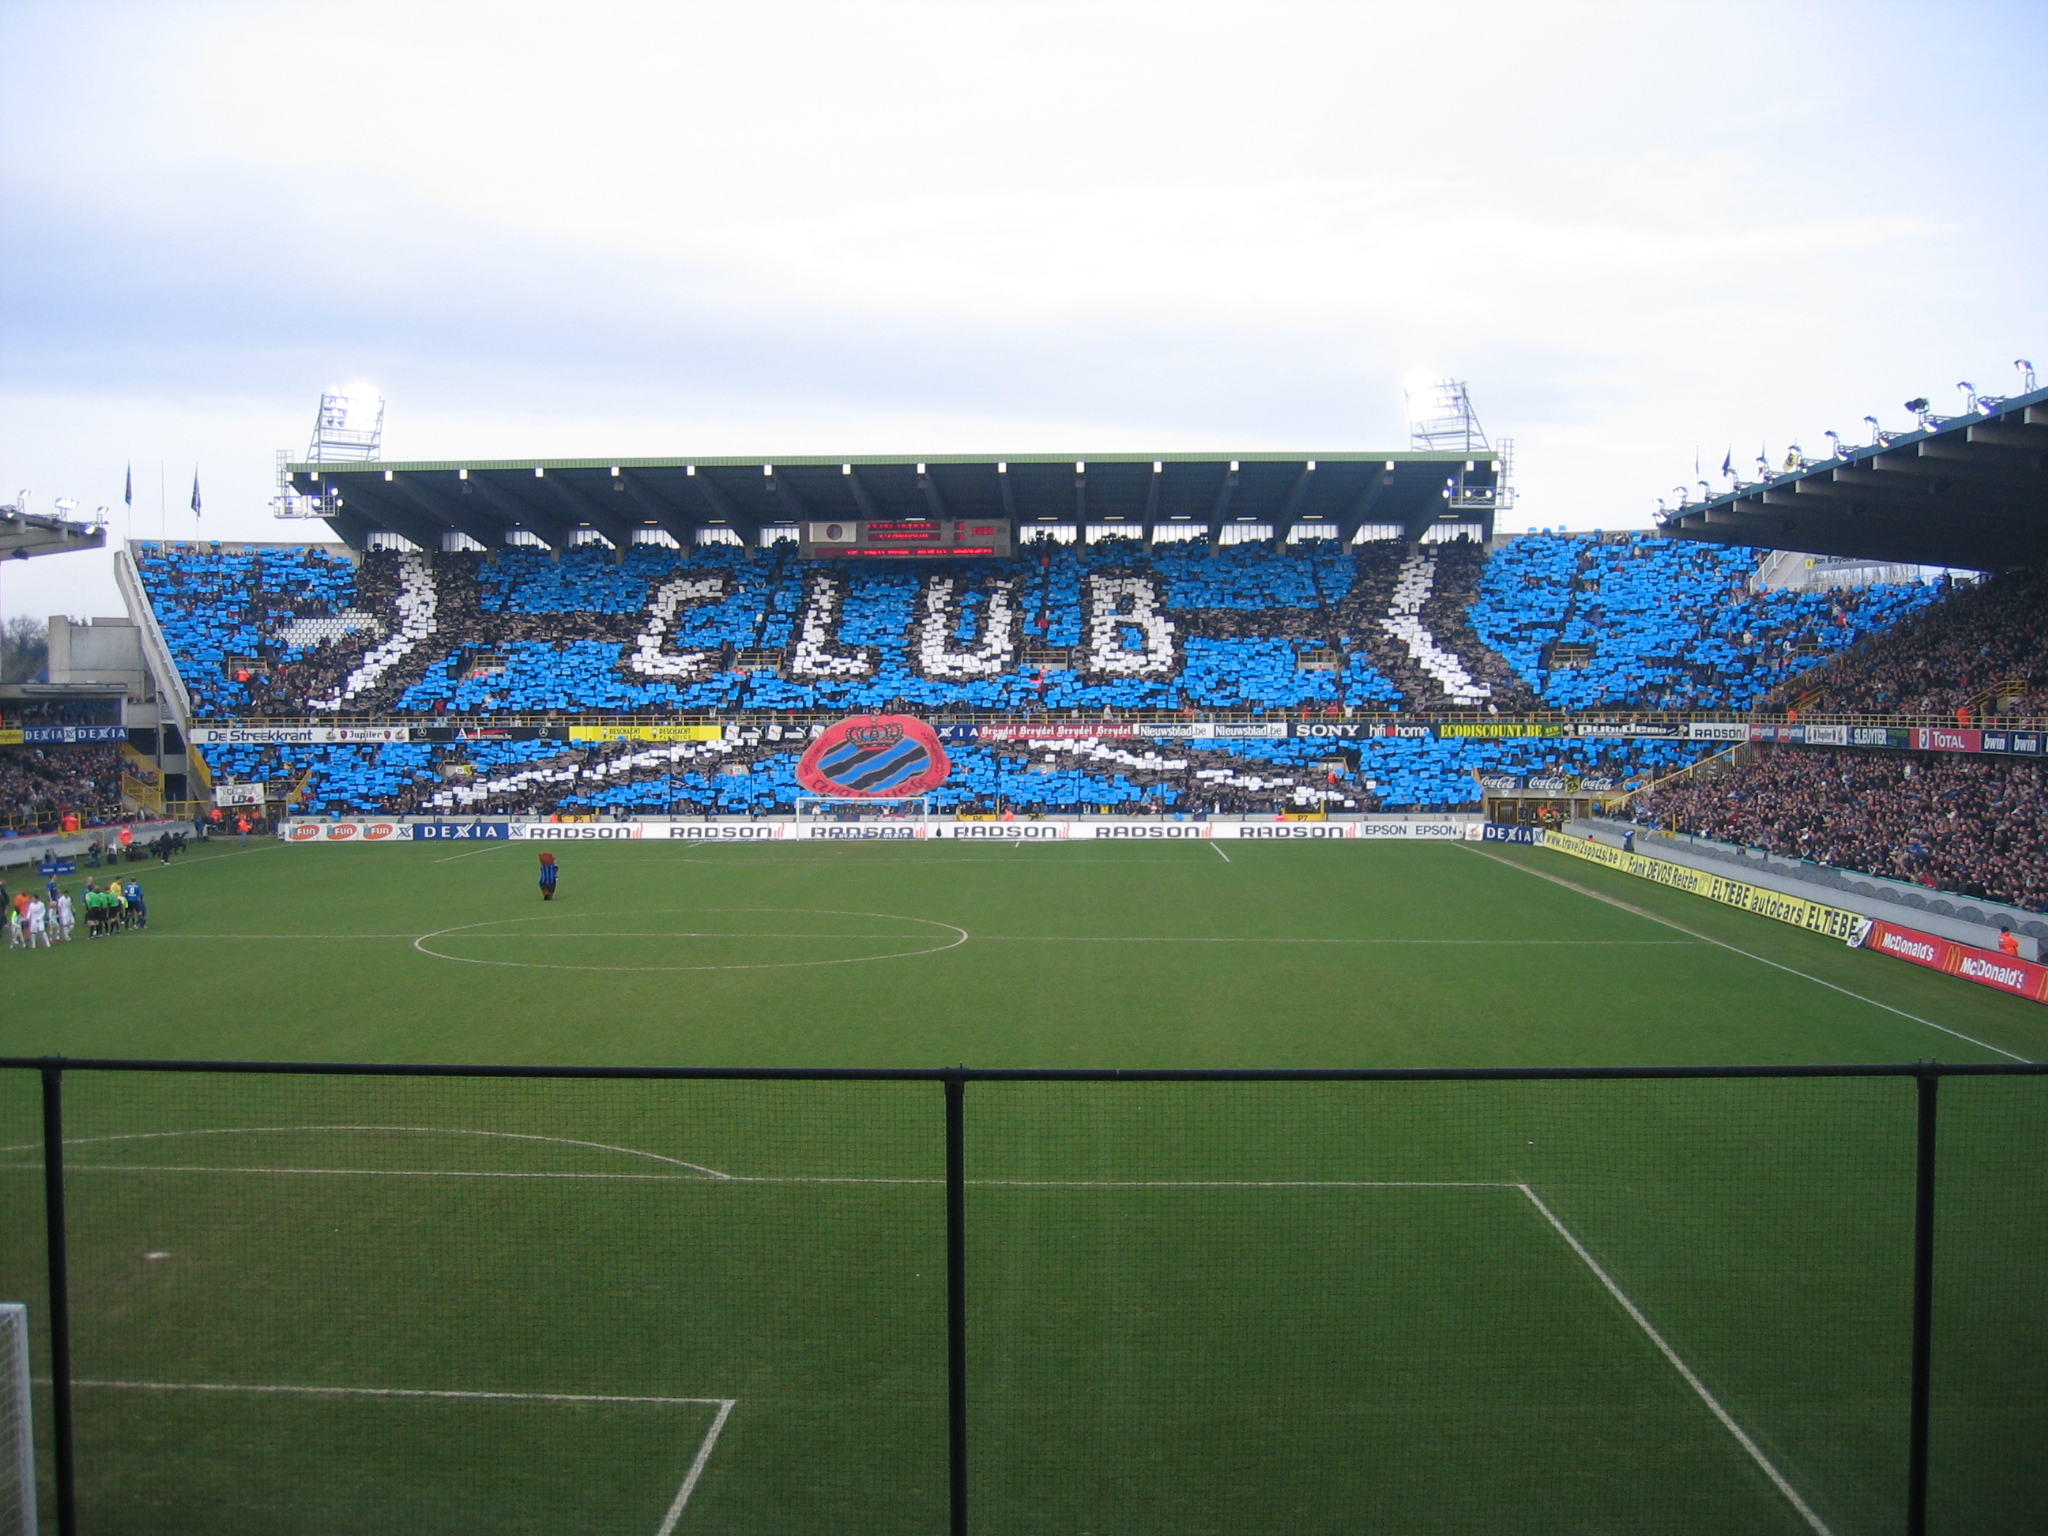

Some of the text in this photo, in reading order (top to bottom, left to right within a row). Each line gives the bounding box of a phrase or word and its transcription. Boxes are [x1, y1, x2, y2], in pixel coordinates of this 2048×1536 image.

[631, 575, 1175, 675] CLUB
[25, 728, 63, 740] DEXIA
[78, 727, 126, 739] DEXIA
[207, 729, 313, 741] De Streekkrant
[349, 731, 383, 740] Jupiler
[1296, 724, 1359, 736] SONY
[1440, 724, 1543, 737] ECODISCOUNT.BE
[1694, 729, 1742, 739] RADSON
[1932, 731, 1965, 748] TOTAL
[1984, 733, 2006, 750] bwin
[2013, 734, 2037, 751] bwin
[297, 828, 316, 836] FUN
[335, 827, 353, 836] FUN
[371, 827, 389, 835] FUN
[424, 824, 498, 839] DEXIA
[530, 827, 631, 838] RADSON
[670, 827, 772, 838] RADSON
[954, 827, 1057, 838] RADSON
[1095, 827, 1200, 838] RADSON
[1240, 827, 1348, 838] RADSON
[1366, 825, 1407, 835] EPSON
[1416, 825, 1457, 836] EPSON
[1486, 826, 1532, 842] DEXIA
[1628, 857, 1699, 891] Frank DEVOS Reizen
[1711, 879, 1859, 939] ELTEBE autocars ELTEBE
[1882, 932, 1935, 962] McDonald's
[1960, 957, 2024, 989] McDonald's
